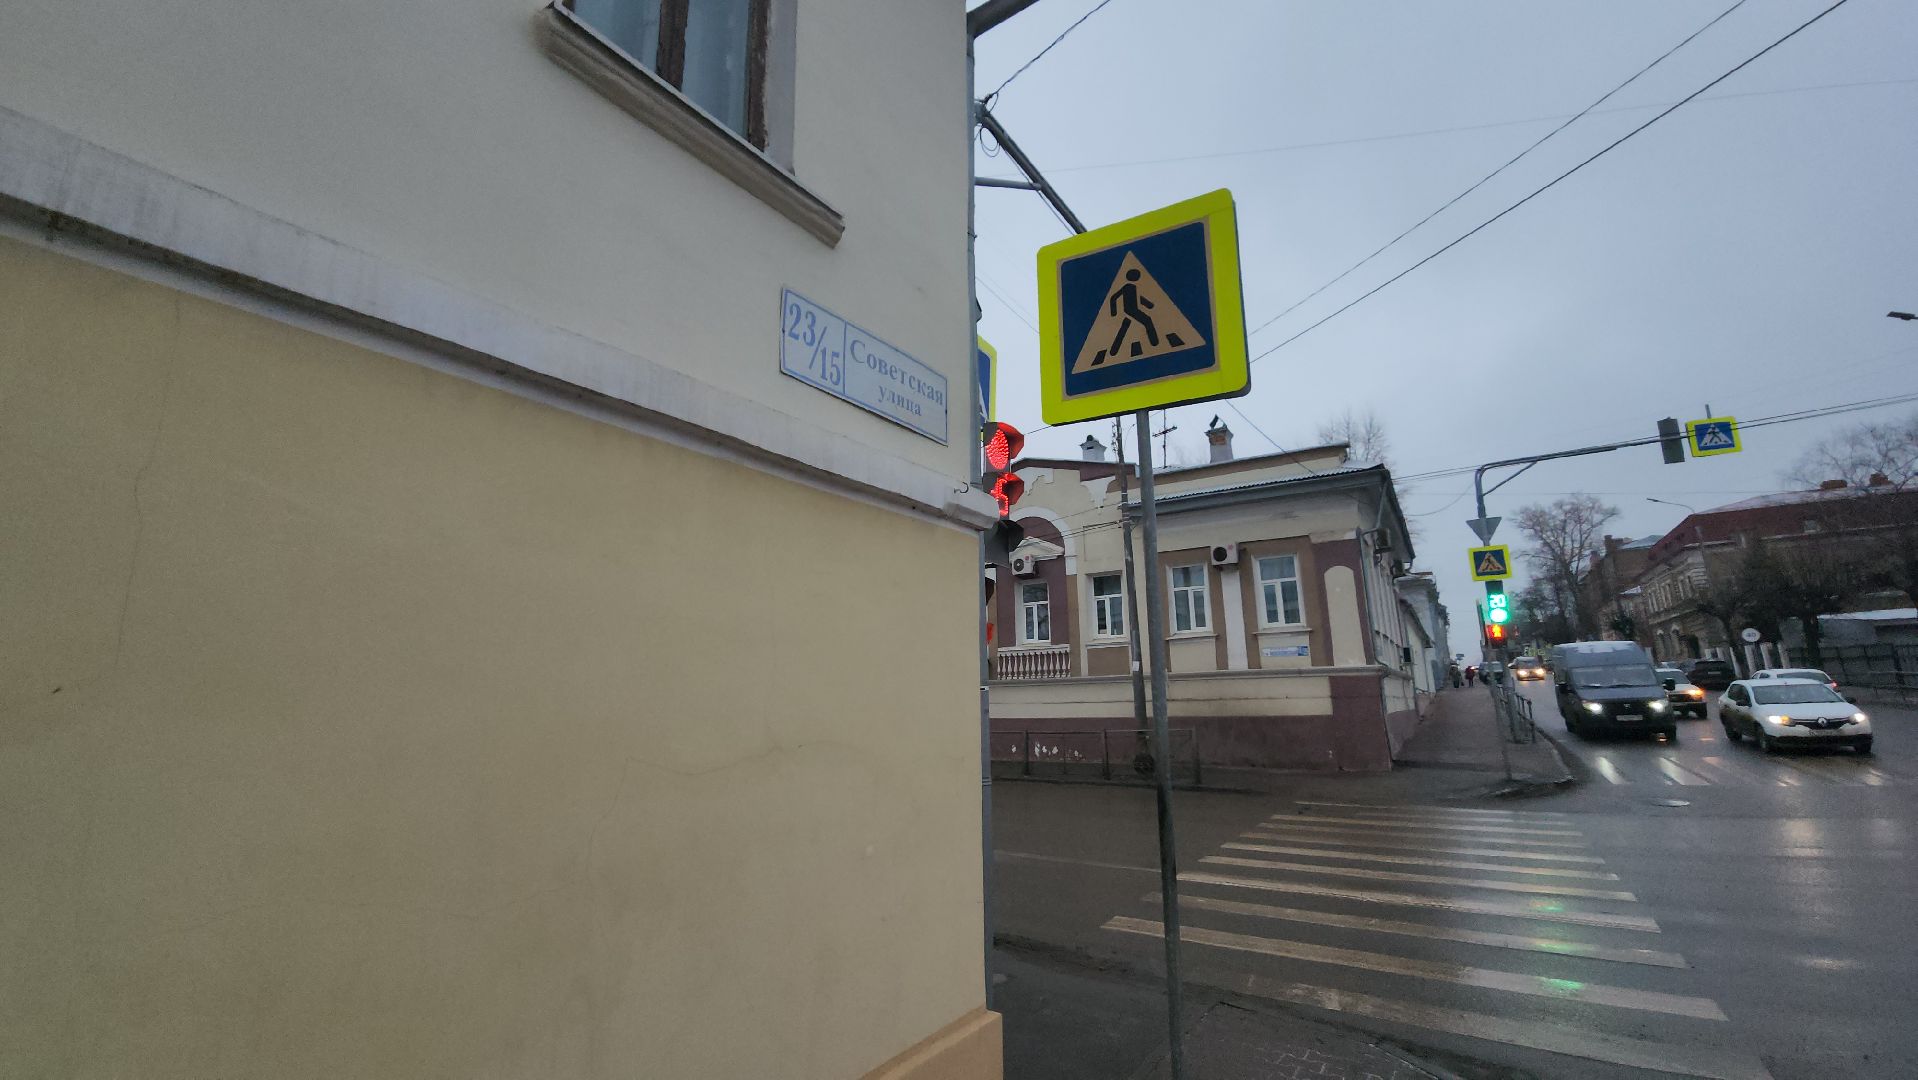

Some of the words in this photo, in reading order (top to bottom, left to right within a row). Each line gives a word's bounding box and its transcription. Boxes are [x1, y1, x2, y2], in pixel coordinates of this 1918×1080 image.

[787, 302, 841, 386] 23/15
[850, 339, 943, 406] Советская
[878, 384, 922, 417] улица
